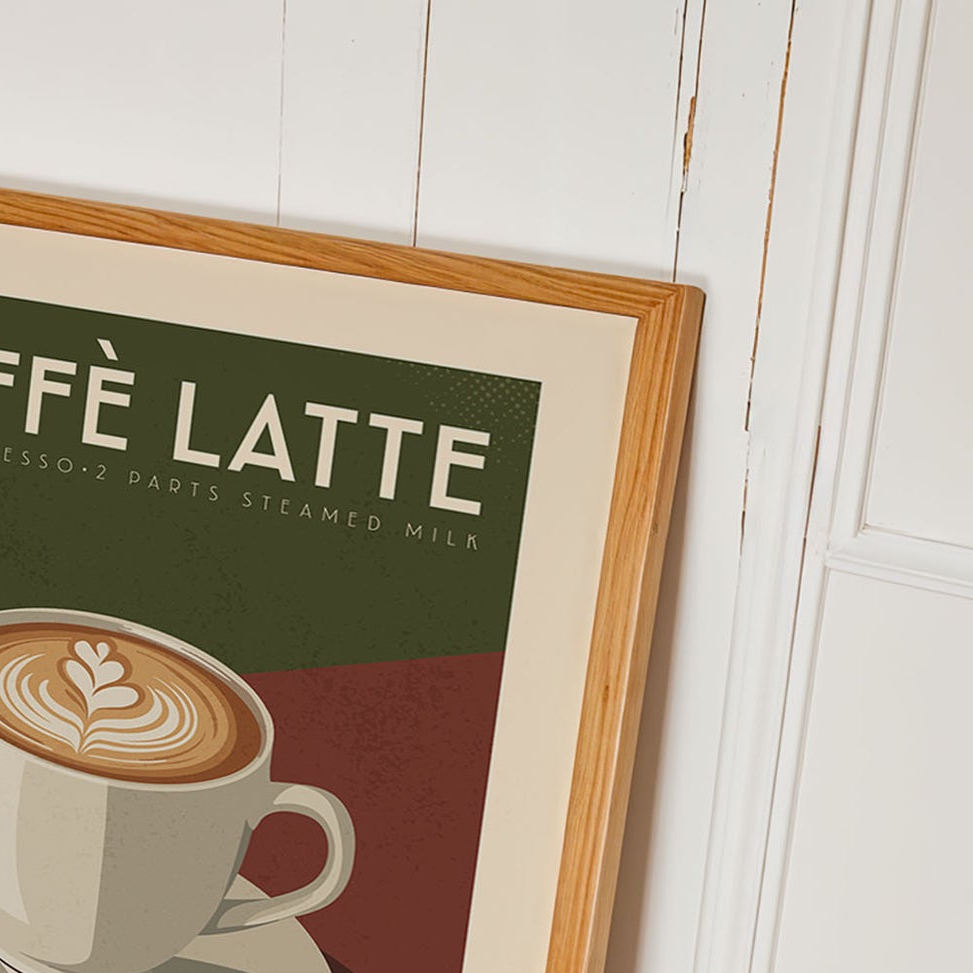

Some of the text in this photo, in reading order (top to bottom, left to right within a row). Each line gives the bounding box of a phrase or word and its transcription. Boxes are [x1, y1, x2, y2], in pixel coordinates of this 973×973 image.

[173, 381, 491, 515] LATTE
[129, 471, 219, 501] PARTS
[242, 492, 381, 532] STEAMED
[405, 523, 478, 550] MILK
